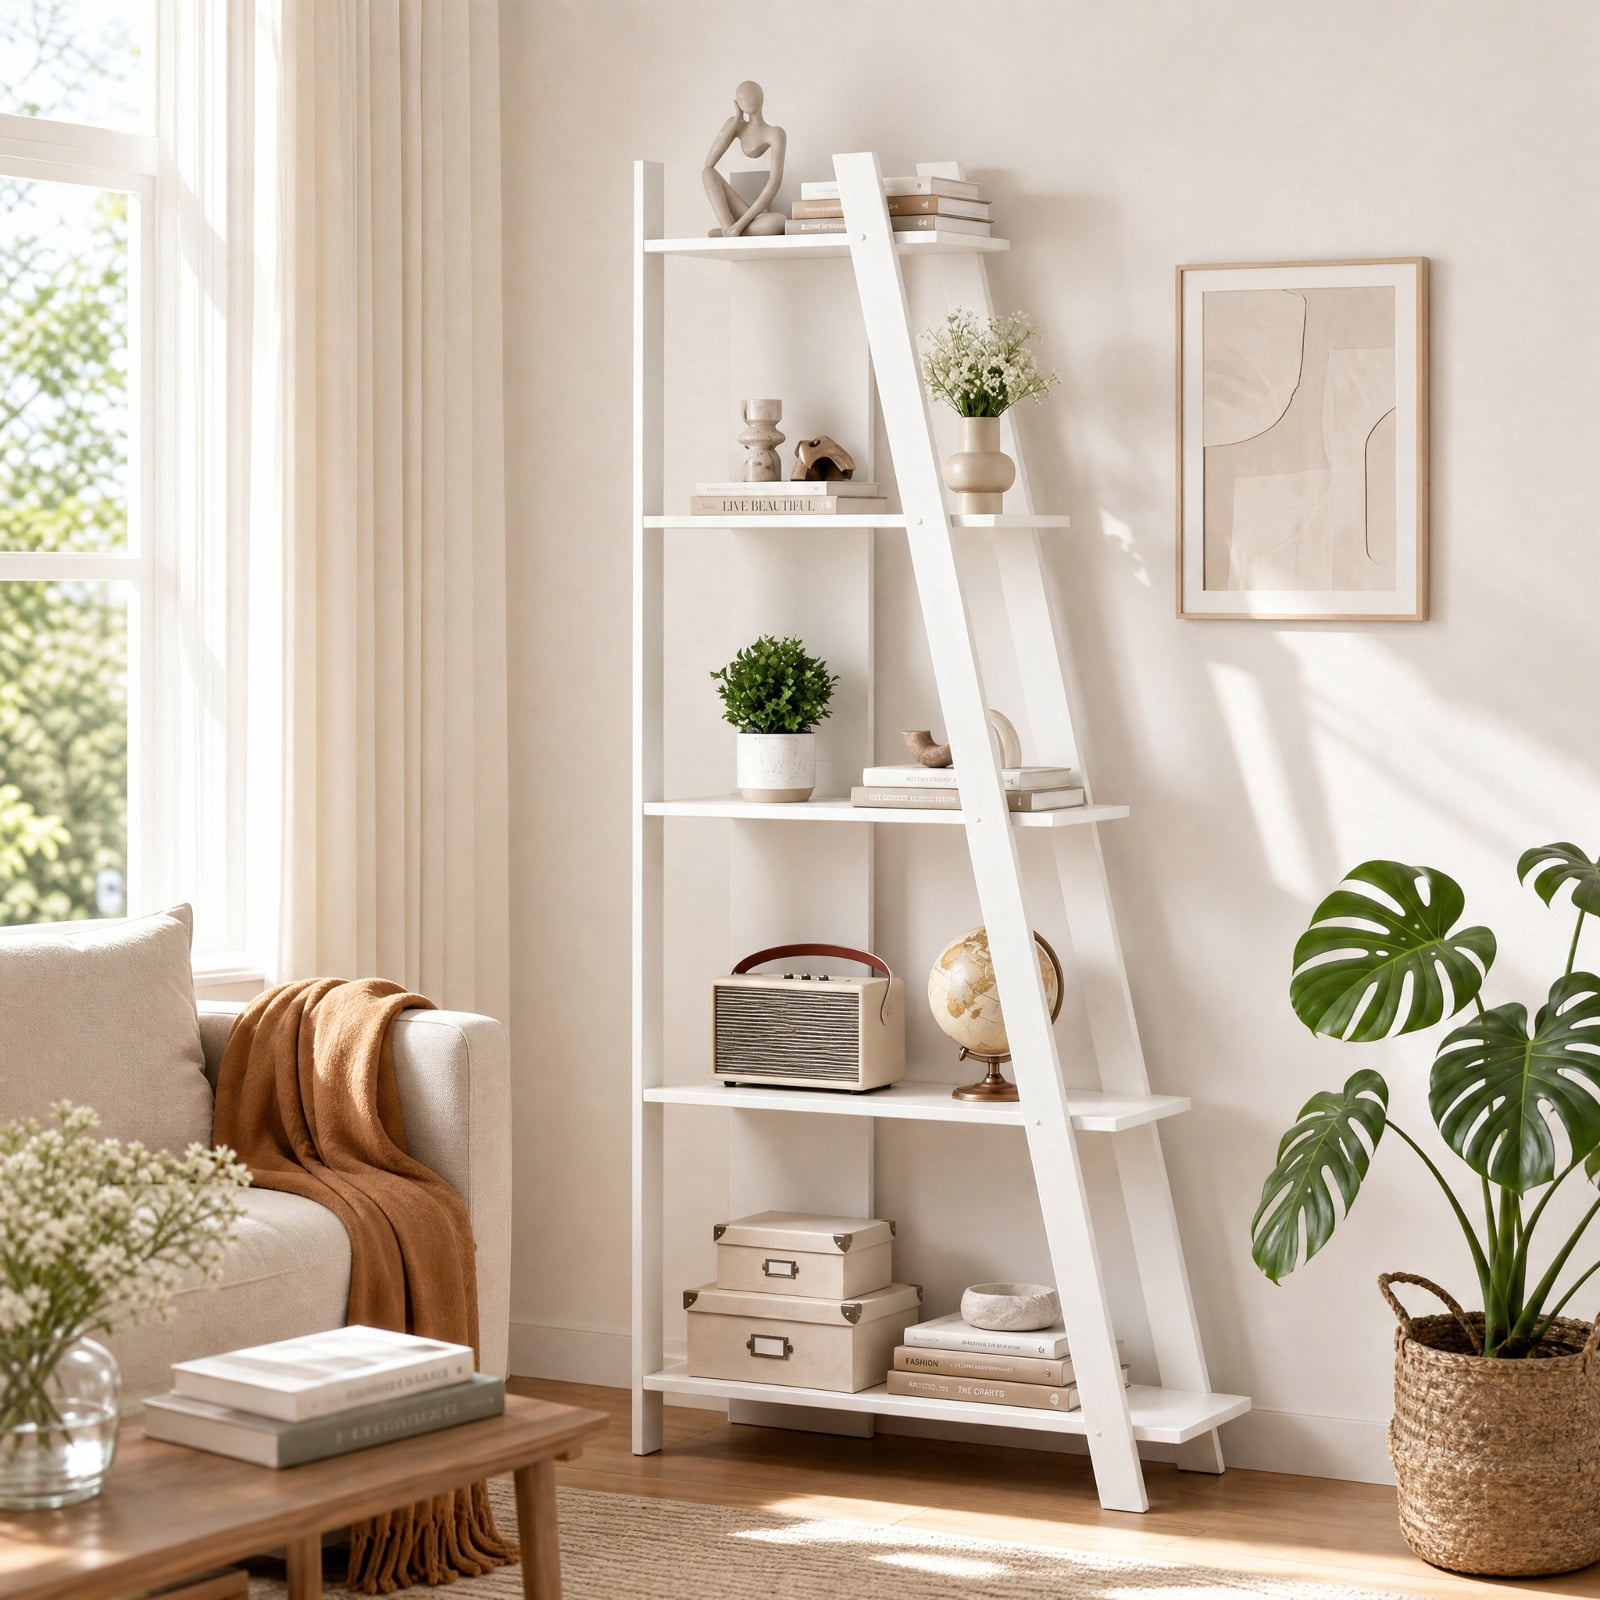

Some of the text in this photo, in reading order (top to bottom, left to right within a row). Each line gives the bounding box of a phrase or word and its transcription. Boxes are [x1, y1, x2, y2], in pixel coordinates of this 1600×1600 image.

[722, 500, 749, 512] LIVE
[751, 500, 815, 512] BEAUTIFUL
[905, 1357, 939, 1368] FASHION
